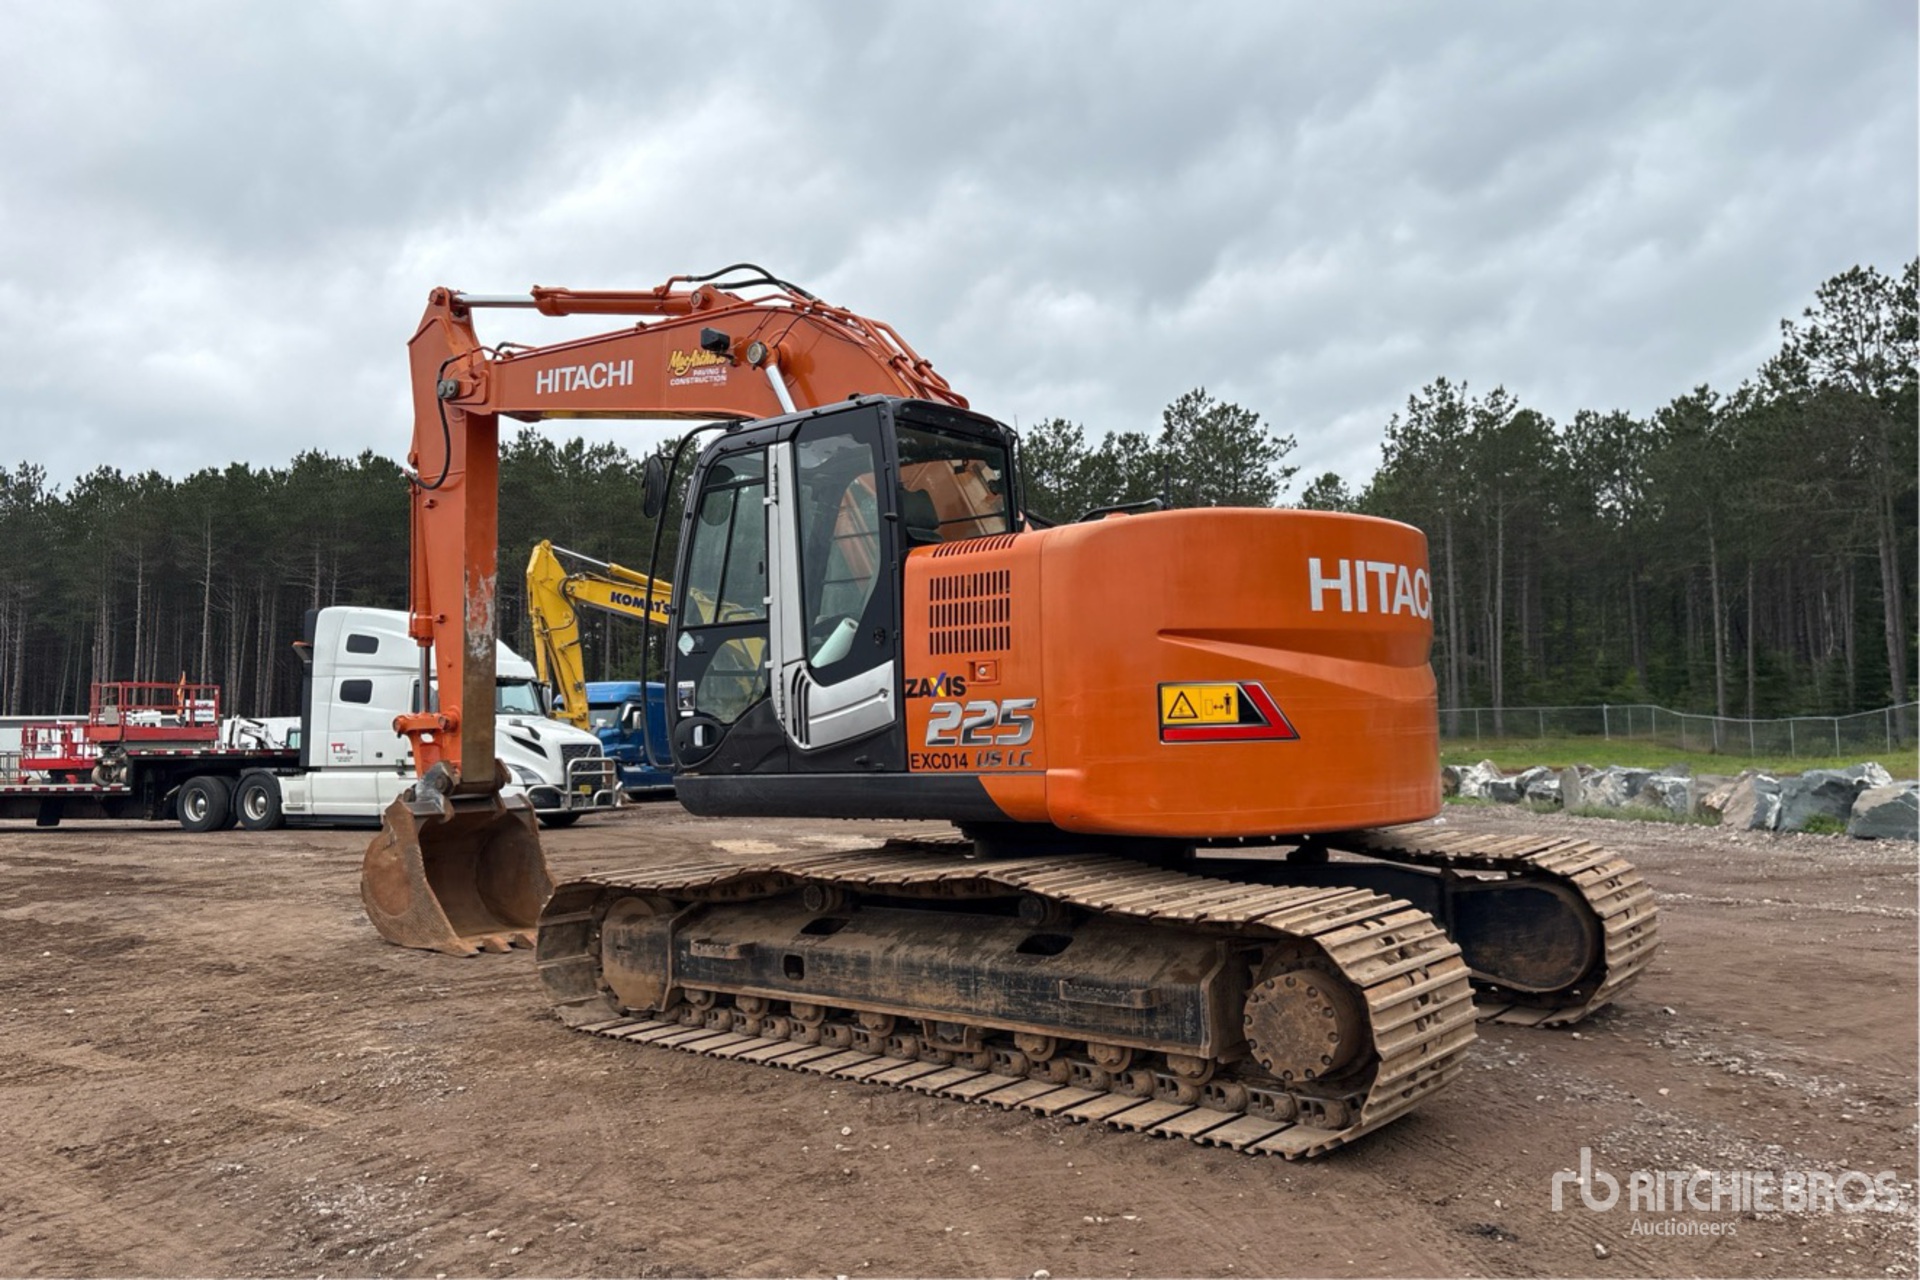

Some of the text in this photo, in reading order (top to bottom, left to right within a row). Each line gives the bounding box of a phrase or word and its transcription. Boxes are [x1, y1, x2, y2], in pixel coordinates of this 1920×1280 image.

[535, 359, 634, 395] HITACHI
[670, 374, 727, 387] CONSTRUCTION
[693, 367, 719, 376] PAVING
[610, 591, 672, 615] KOMTS
[905, 672, 967, 698] ZAXIS
[925, 698, 1038, 747] 225
[910, 752, 968, 770] EXC014
